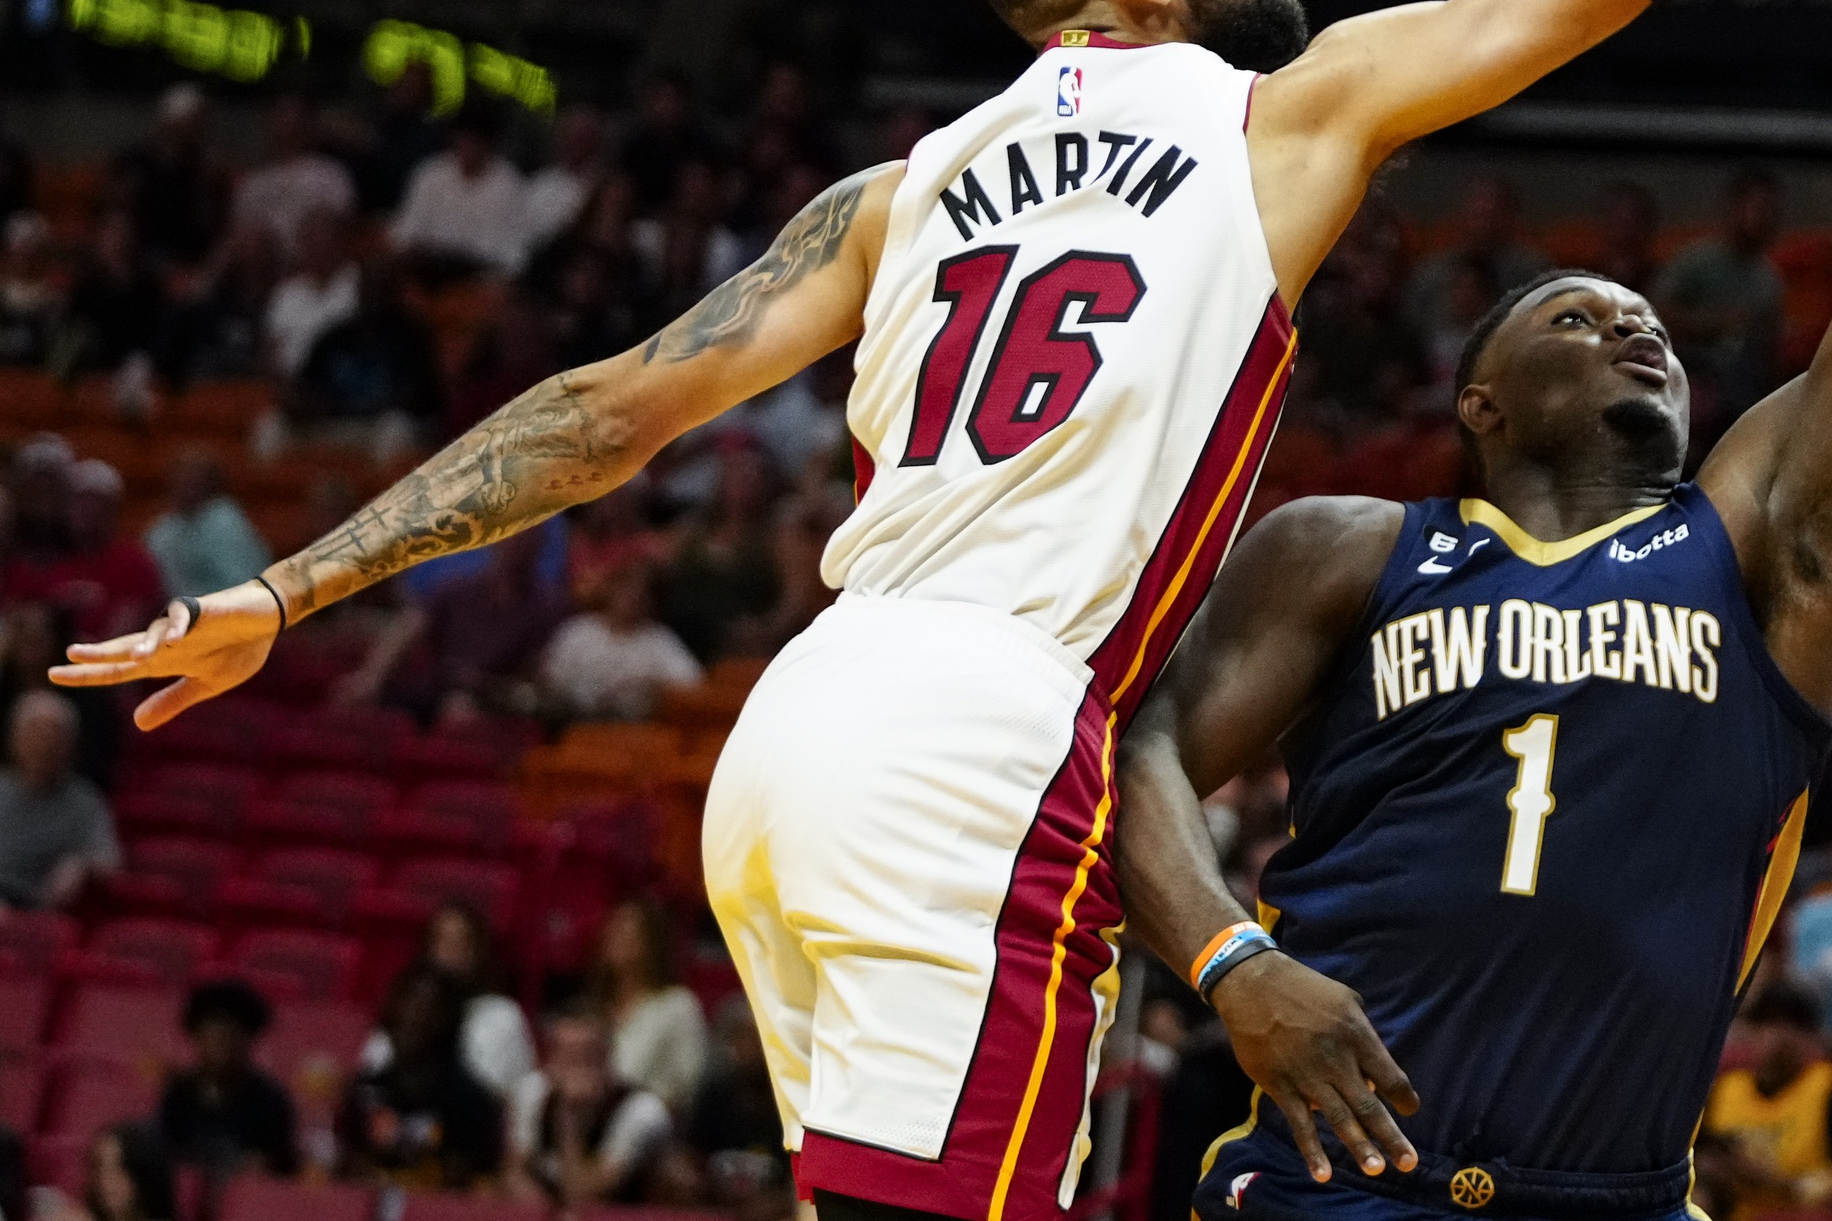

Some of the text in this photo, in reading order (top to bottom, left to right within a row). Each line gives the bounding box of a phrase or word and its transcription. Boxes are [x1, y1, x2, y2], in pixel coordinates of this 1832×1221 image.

[939, 131, 1199, 242] MARTIN
[897, 244, 1148, 468] 16
[1607, 523, 1690, 564] ibotta
[1371, 598, 1721, 721] NEW ORLEANS
[1500, 712, 1559, 897] 1
